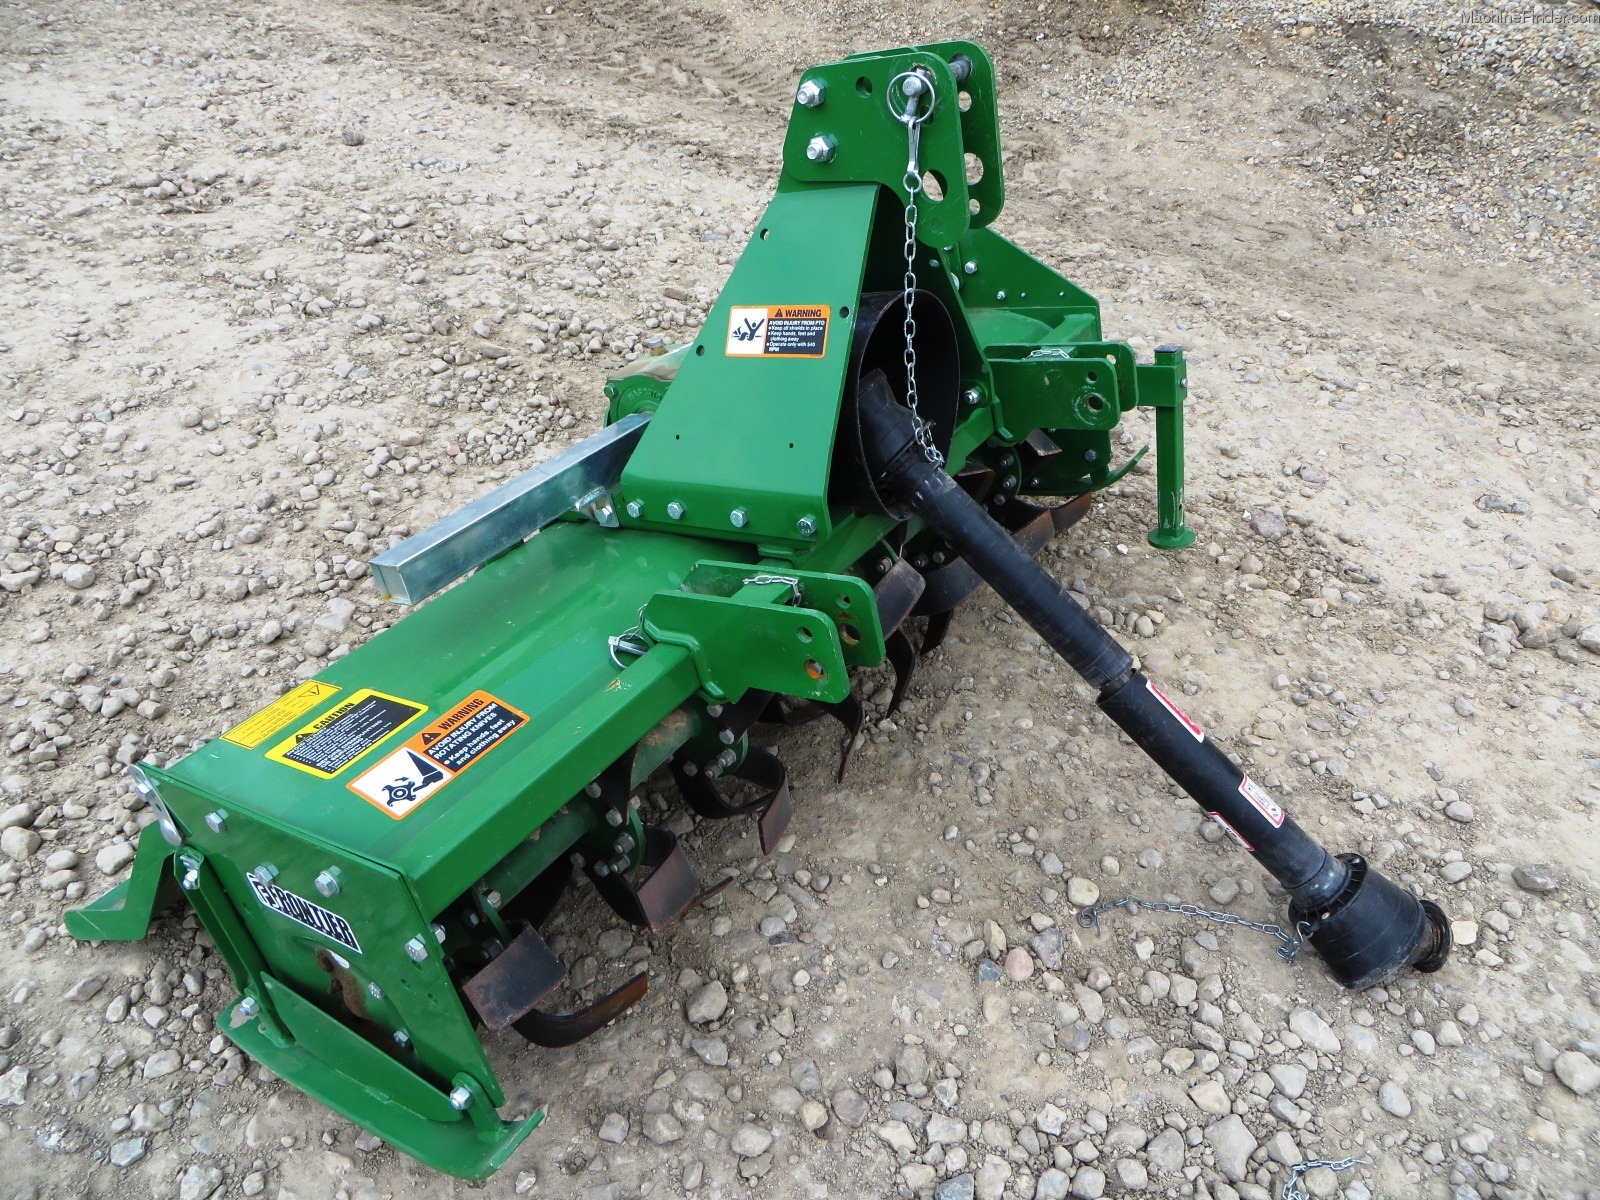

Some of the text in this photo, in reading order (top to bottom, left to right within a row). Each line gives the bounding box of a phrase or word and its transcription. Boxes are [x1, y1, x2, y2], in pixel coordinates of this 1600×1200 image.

[785, 309, 822, 318] WARNING
[313, 702, 356, 730] CAUTION
[428, 702, 498, 756] AVOID INJURY FROM
[437, 698, 485, 730] WARNING
[433, 712, 498, 760] ROTATING KNIVES
[448, 718, 506, 761] Keep hands, feet
[456, 719, 516, 765] and clothing away
